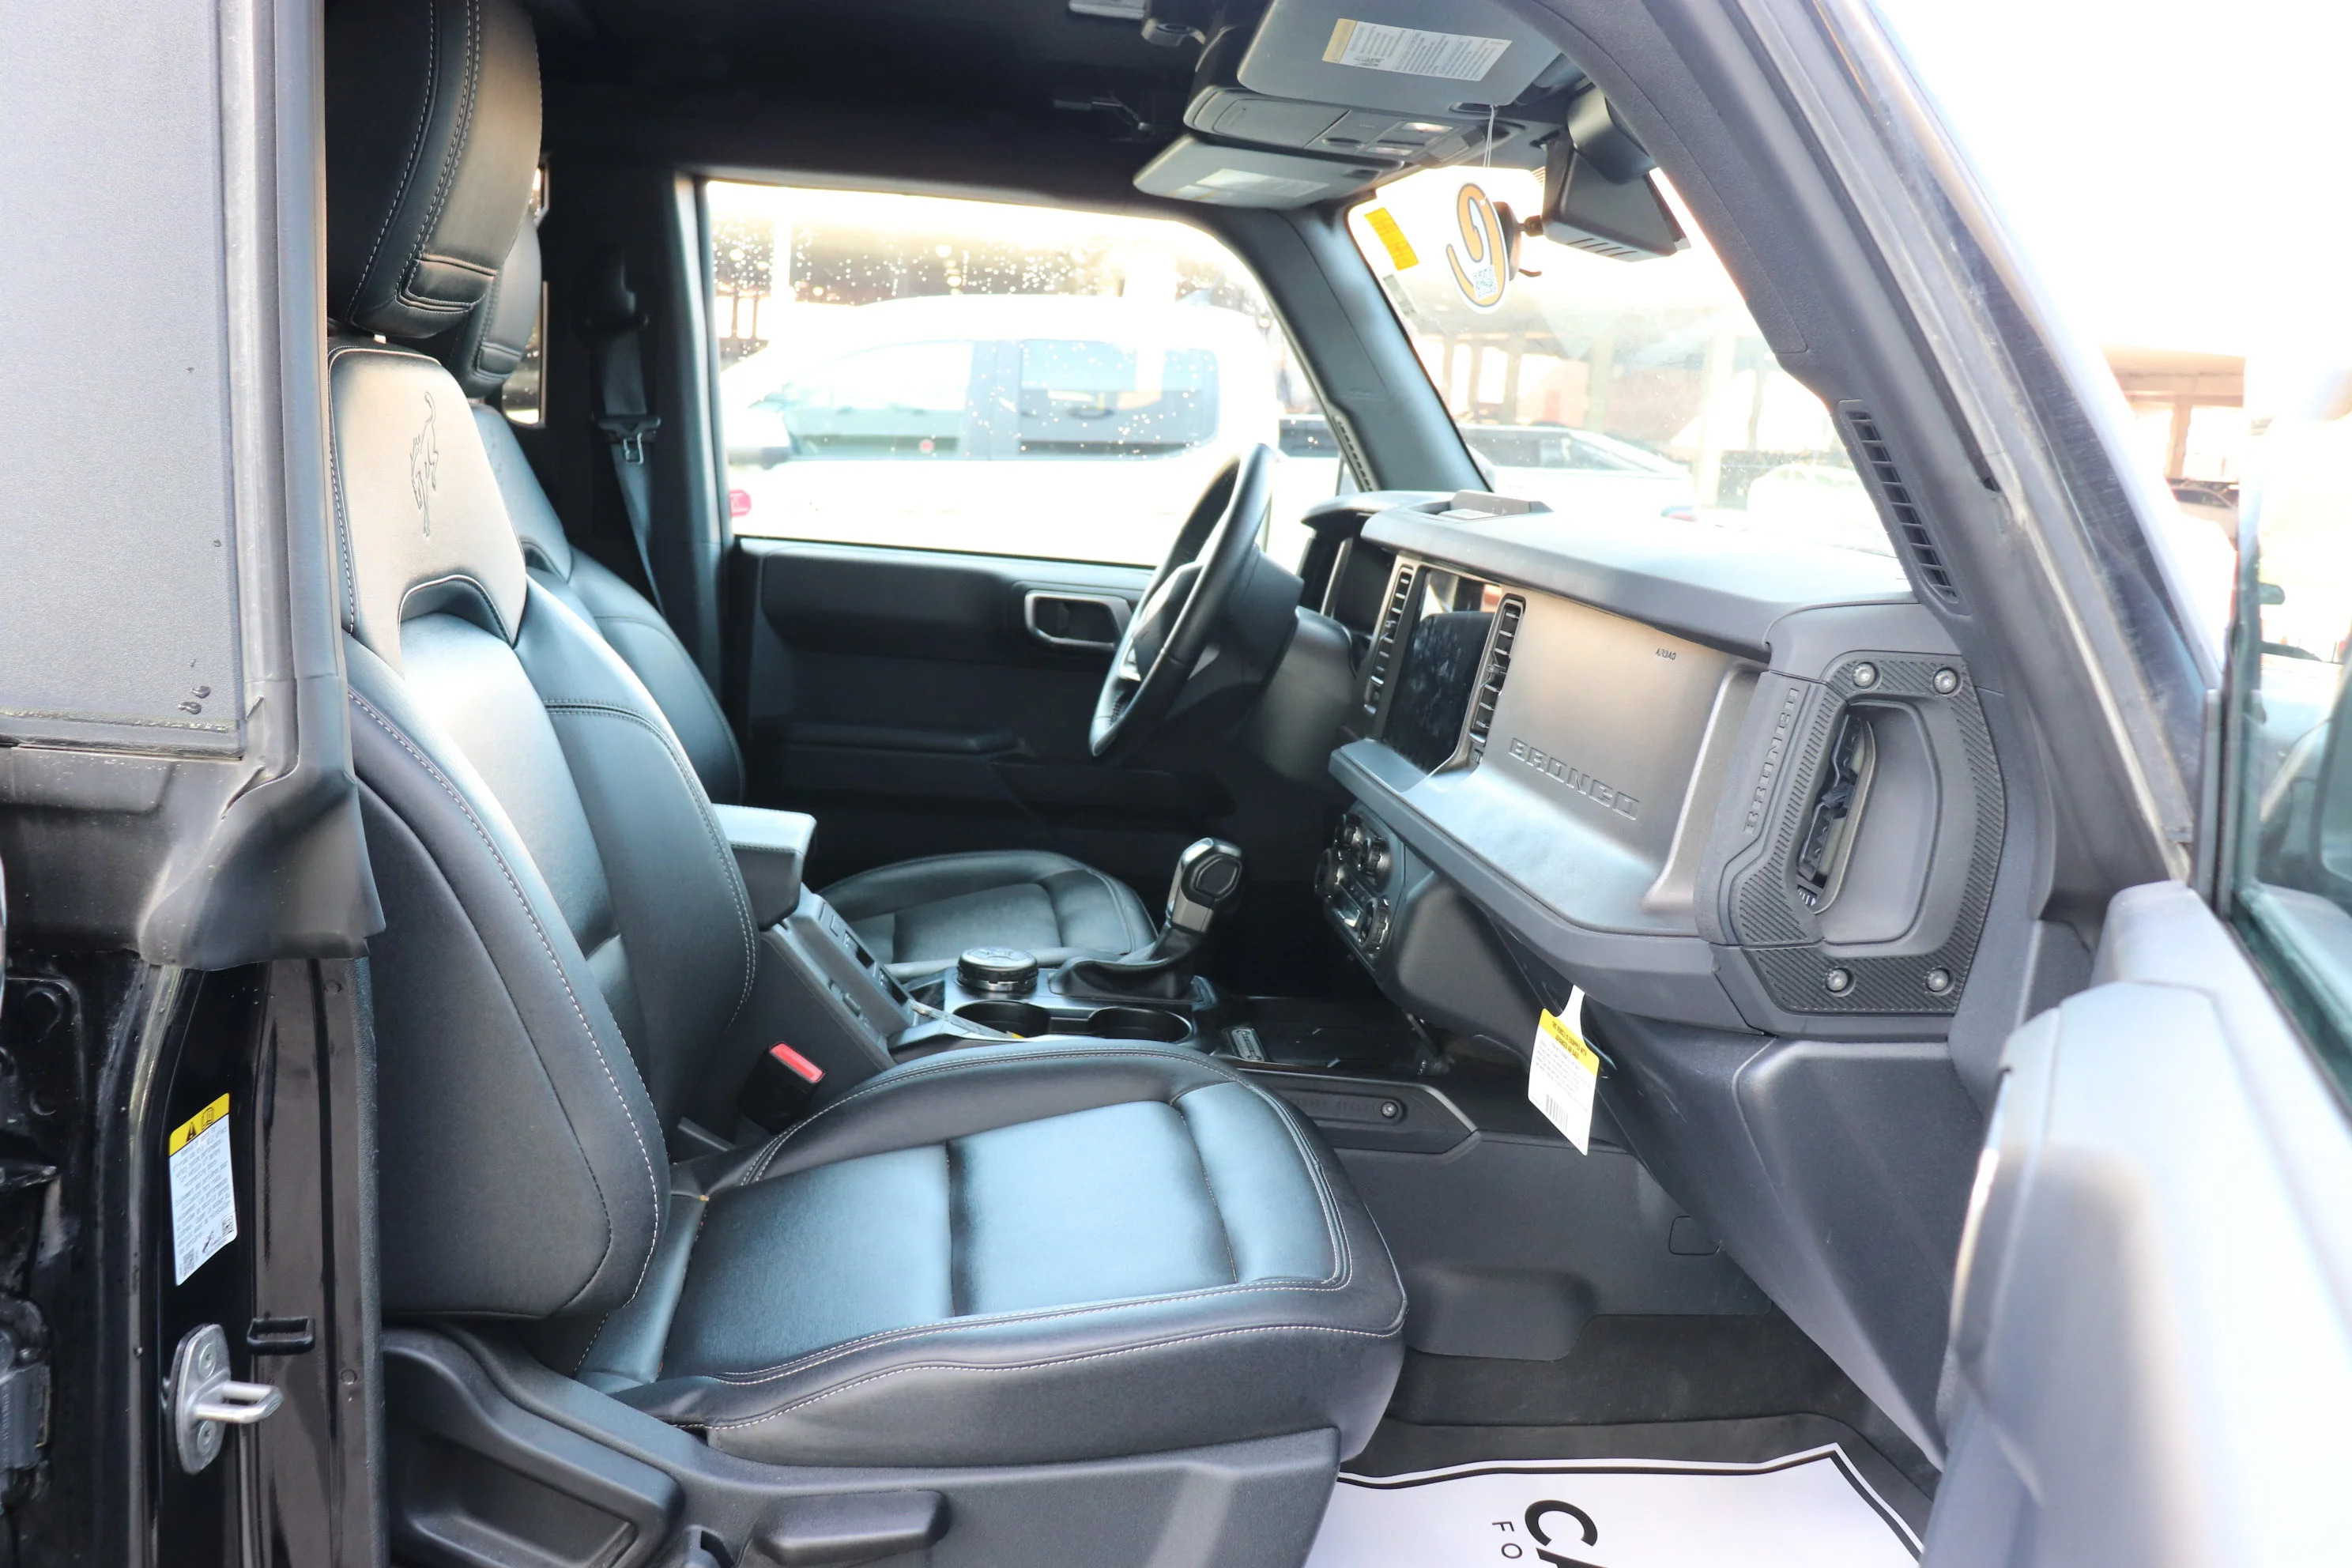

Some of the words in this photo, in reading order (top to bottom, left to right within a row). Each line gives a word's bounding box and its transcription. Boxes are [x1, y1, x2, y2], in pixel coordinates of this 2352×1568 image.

[1655, 647, 1676, 661] AIRBAG
[1508, 737, 1641, 821] BRONCO
[1743, 688, 1800, 836] BRONCO
